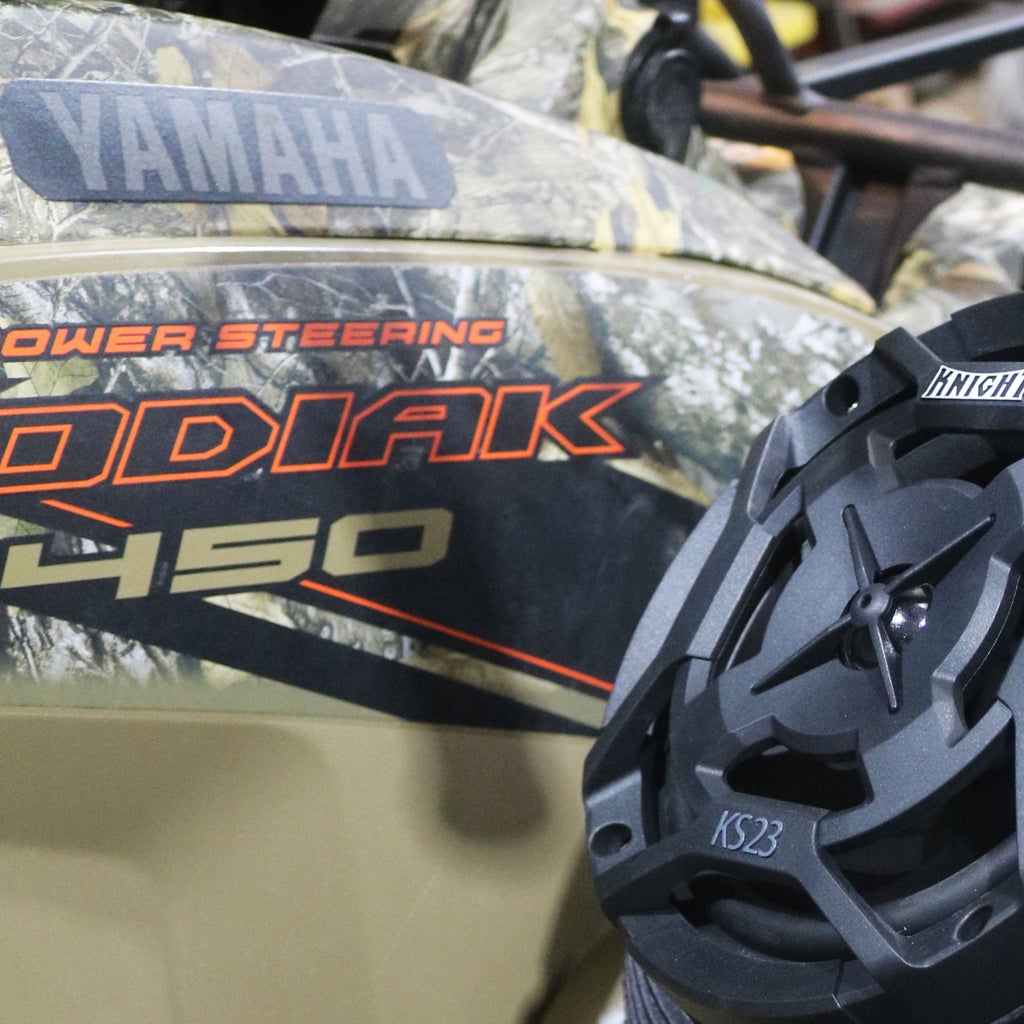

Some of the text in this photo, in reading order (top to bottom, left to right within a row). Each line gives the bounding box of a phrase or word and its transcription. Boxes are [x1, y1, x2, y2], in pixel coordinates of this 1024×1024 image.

[40, 92, 427, 199] YAMAHA
[215, 320, 505, 350] STEERING
[2, 508, 454, 600] 450
[710, 810, 784, 858] KS23
